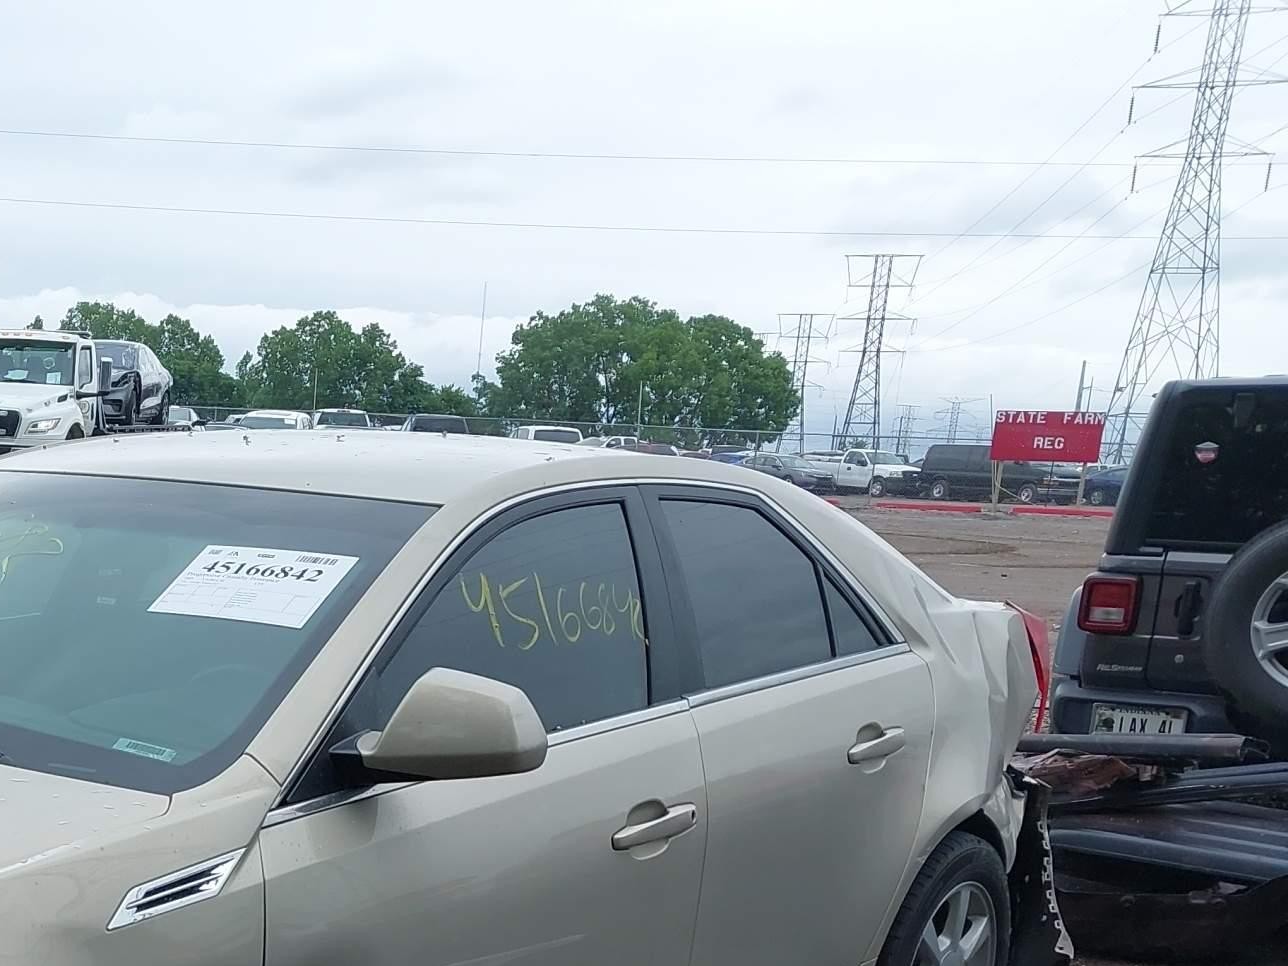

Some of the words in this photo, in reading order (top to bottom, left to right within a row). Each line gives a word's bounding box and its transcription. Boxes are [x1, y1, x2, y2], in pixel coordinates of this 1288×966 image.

[996, 411, 1047, 424] STATE
[1063, 412, 1106, 425] FARM
[1033, 436, 1065, 449] REG
[202, 560, 325, 583] 45166842
